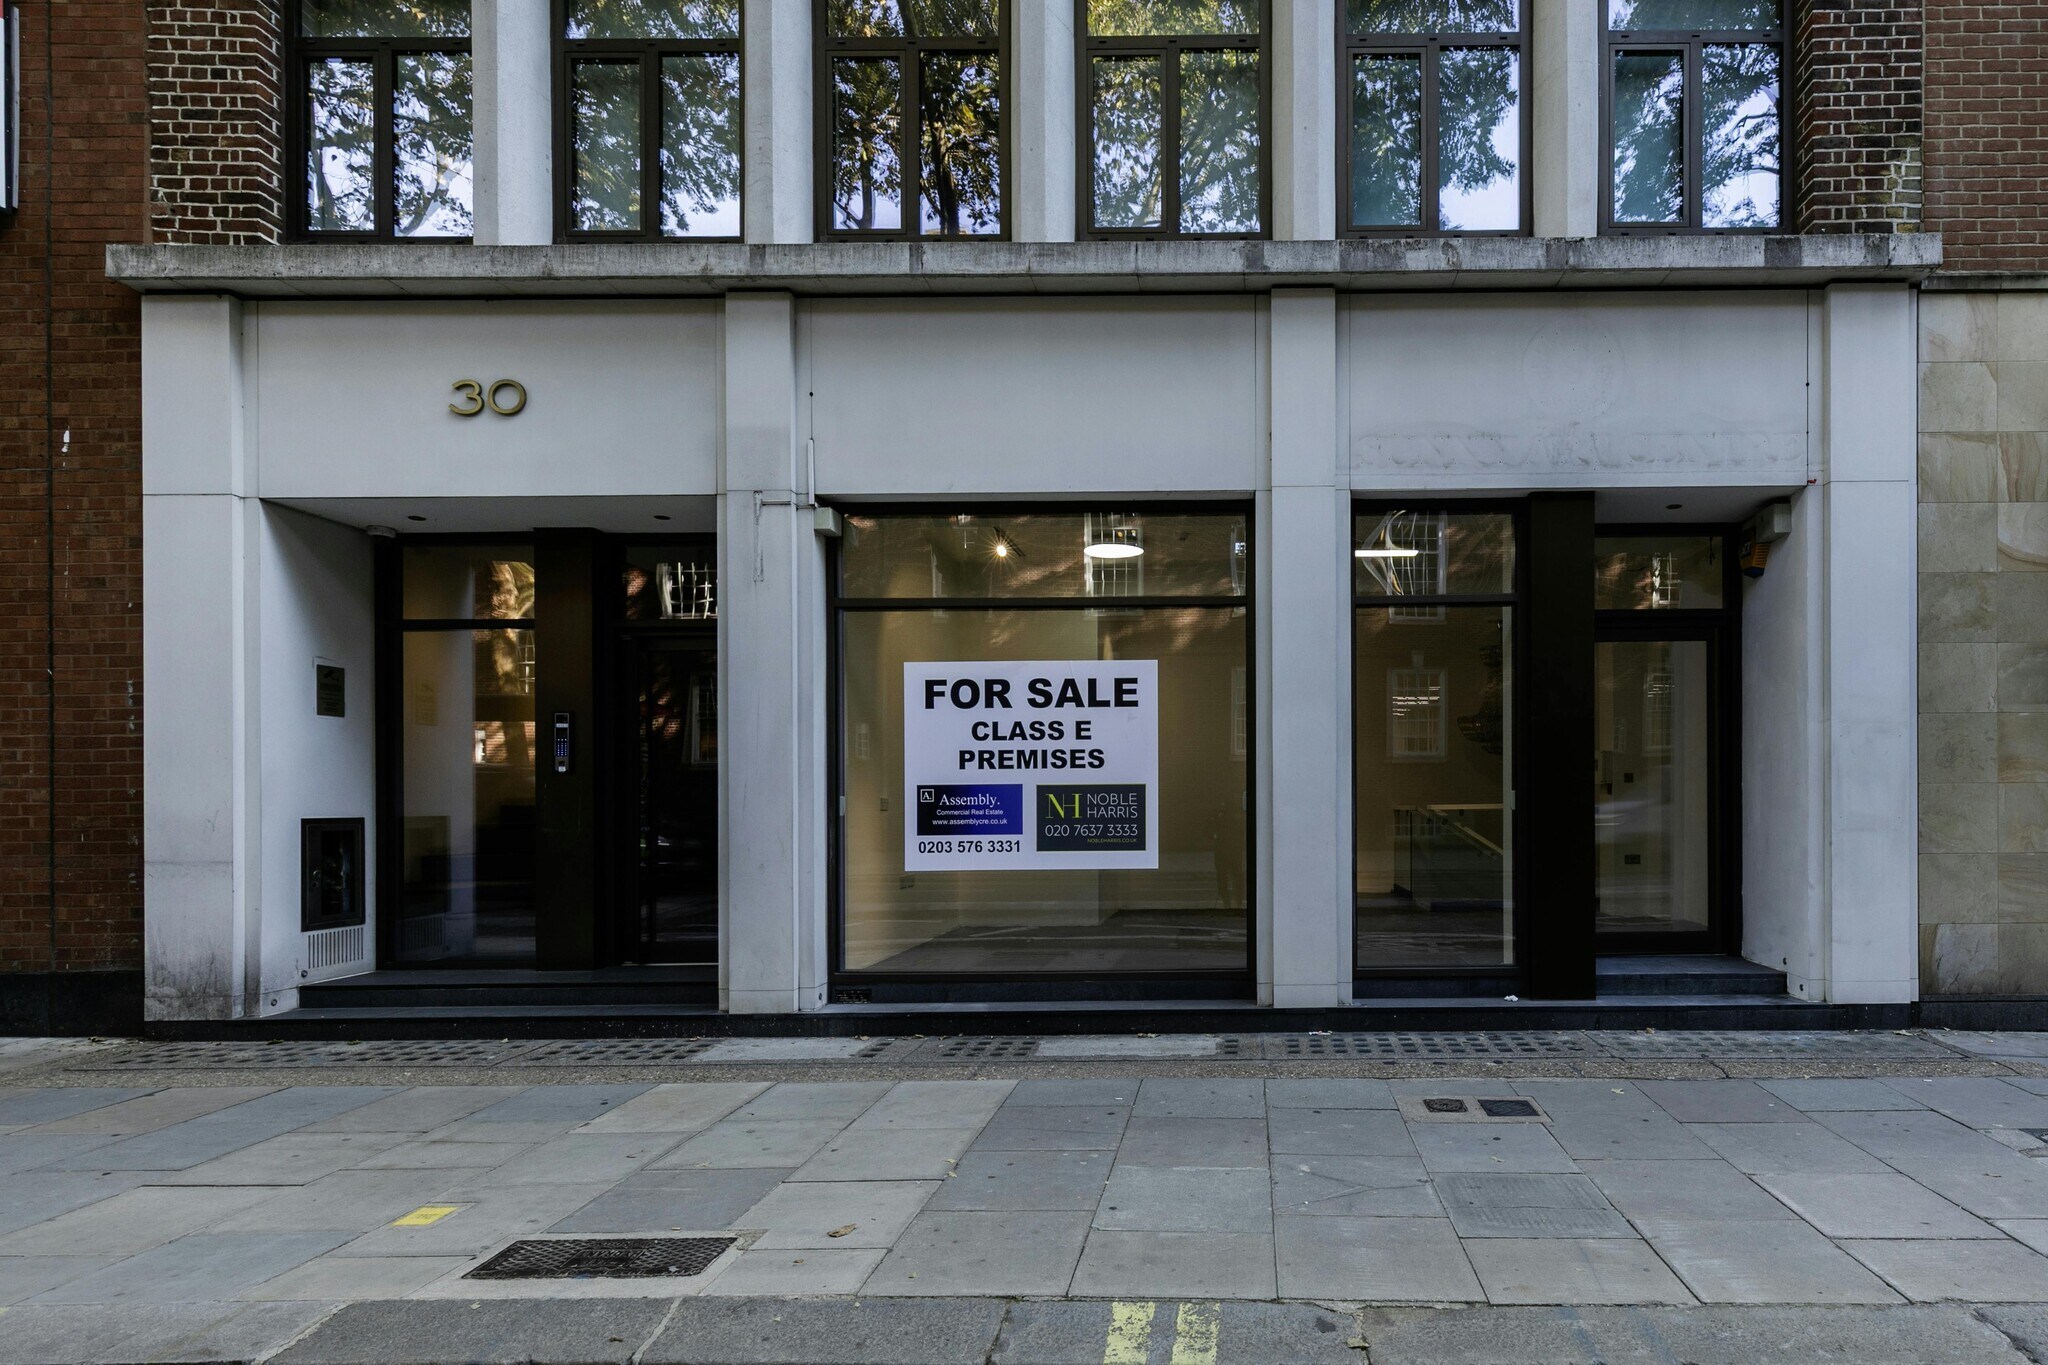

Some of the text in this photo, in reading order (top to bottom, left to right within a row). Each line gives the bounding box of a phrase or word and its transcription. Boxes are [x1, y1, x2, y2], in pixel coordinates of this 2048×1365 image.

[448, 379, 527, 416] 30
[924, 677, 1139, 710] FOR SALE
[971, 720, 1092, 742] CLASS E
[958, 748, 1105, 770] PREMISES
[939, 793, 1001, 808] Assembly.
[1087, 793, 1138, 805] NOBLE
[1087, 806, 1138, 818] HARRIS
[932, 817, 1008, 826] www.assemblycre.co.uk
[1045, 824, 1138, 837] 020 7637 3333
[918, 840, 1020, 853] 0203 576 3331
